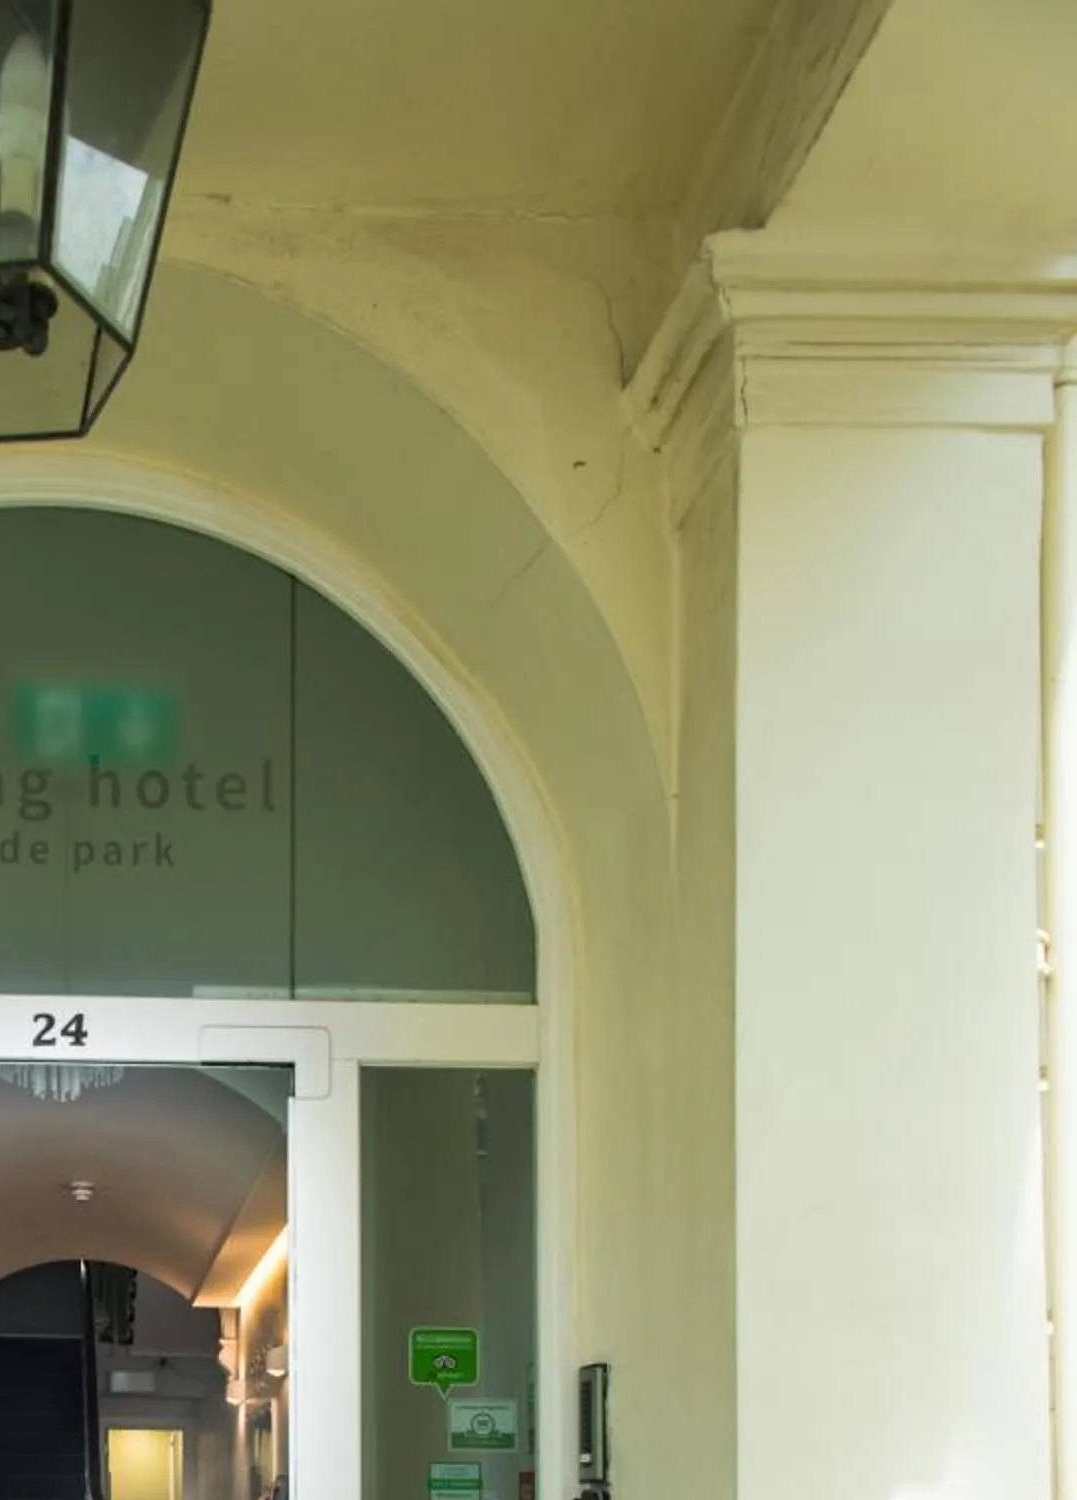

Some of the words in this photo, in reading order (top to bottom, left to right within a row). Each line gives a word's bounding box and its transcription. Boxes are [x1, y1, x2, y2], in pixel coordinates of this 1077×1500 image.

[88, 753, 276, 812] hotel
[73, 832, 175, 873] park
[32, 1012, 88, 1047] 24
